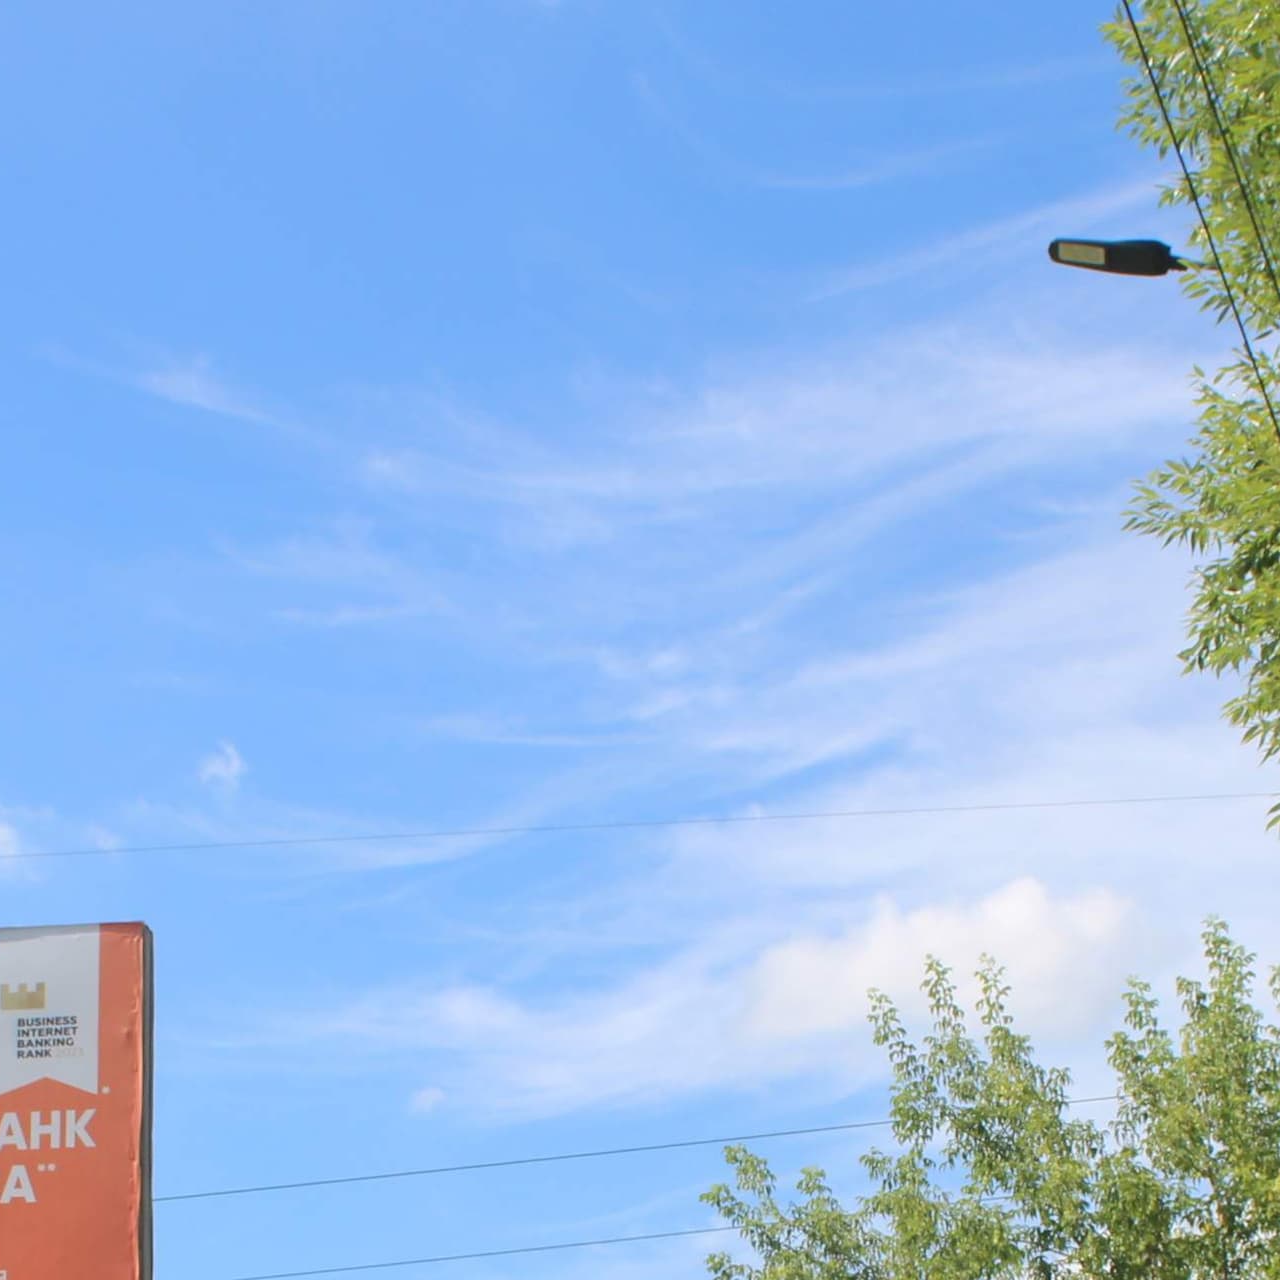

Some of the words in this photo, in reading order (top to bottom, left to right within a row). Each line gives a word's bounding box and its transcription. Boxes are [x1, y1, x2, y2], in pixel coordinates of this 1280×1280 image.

[17, 1016, 78, 1027] BUSINESS
[17, 1026, 78, 1037] INTERNET
[17, 1037, 74, 1048] BANKING
[17, 1048, 52, 1059] RANK
